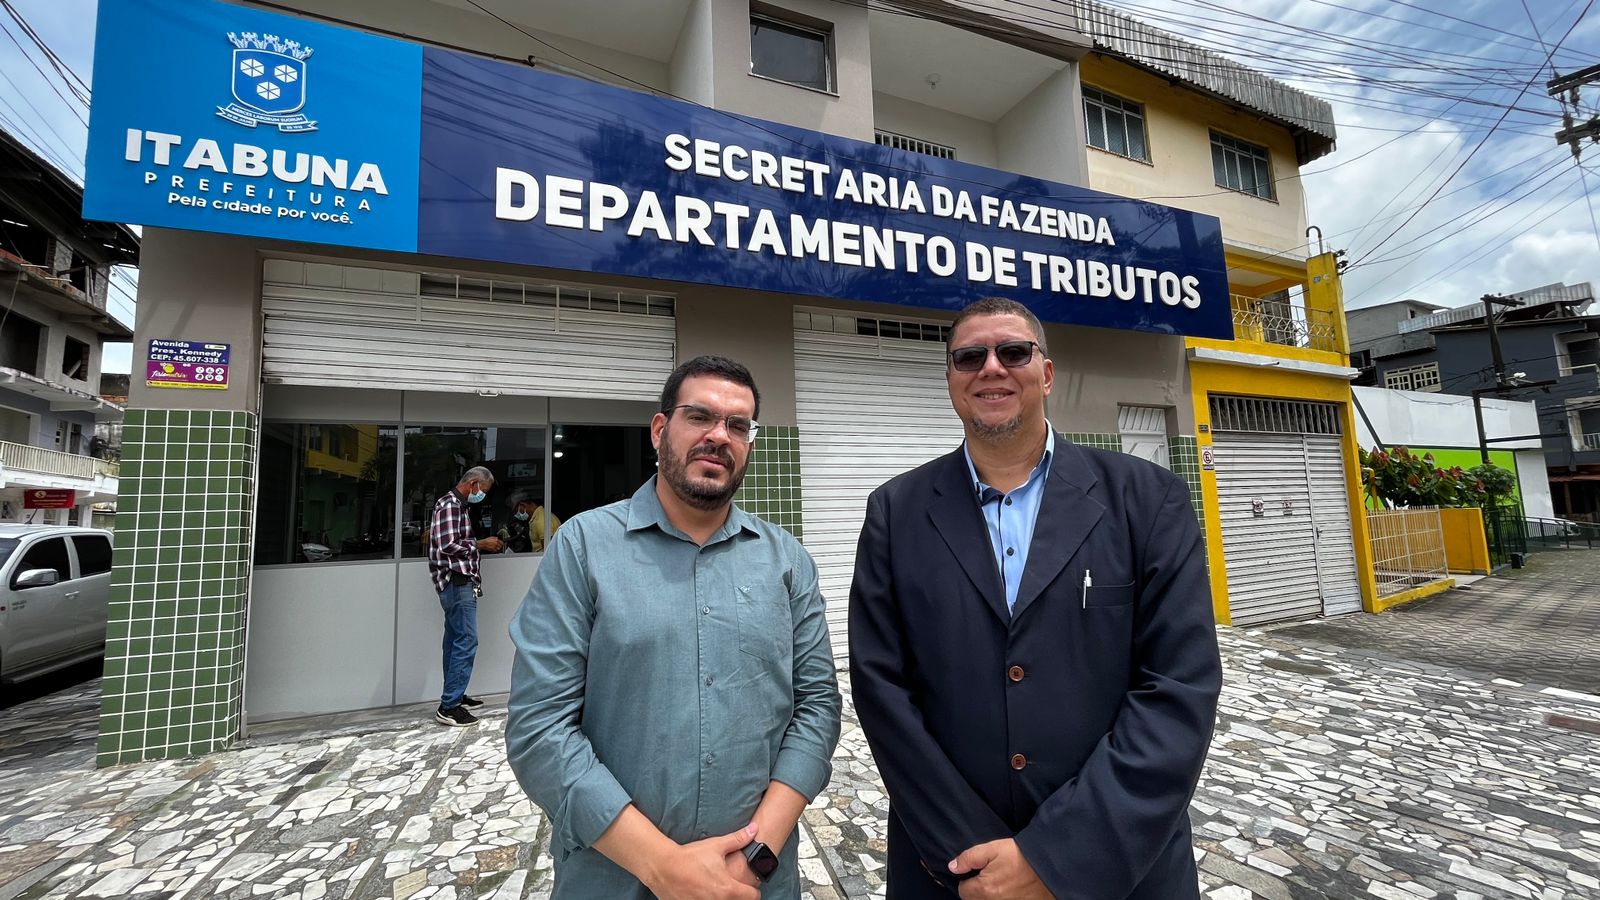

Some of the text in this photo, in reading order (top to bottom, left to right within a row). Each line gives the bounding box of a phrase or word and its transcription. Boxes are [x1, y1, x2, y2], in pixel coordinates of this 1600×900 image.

[125, 128, 389, 195] ITABUNA
[145, 172, 370, 211] PREFEITURA
[664, 133, 1115, 246] SECRETARIA DA FAZENDA
[168, 192, 354, 225] Pela cidade por você.
[495, 166, 1201, 309] DEPARTAMENTO DE TRIBUTOS
[152, 340, 189, 348] Avenida
[173, 355, 219, 363] 45.607-338
[180, 349, 222, 358] Kennedy
